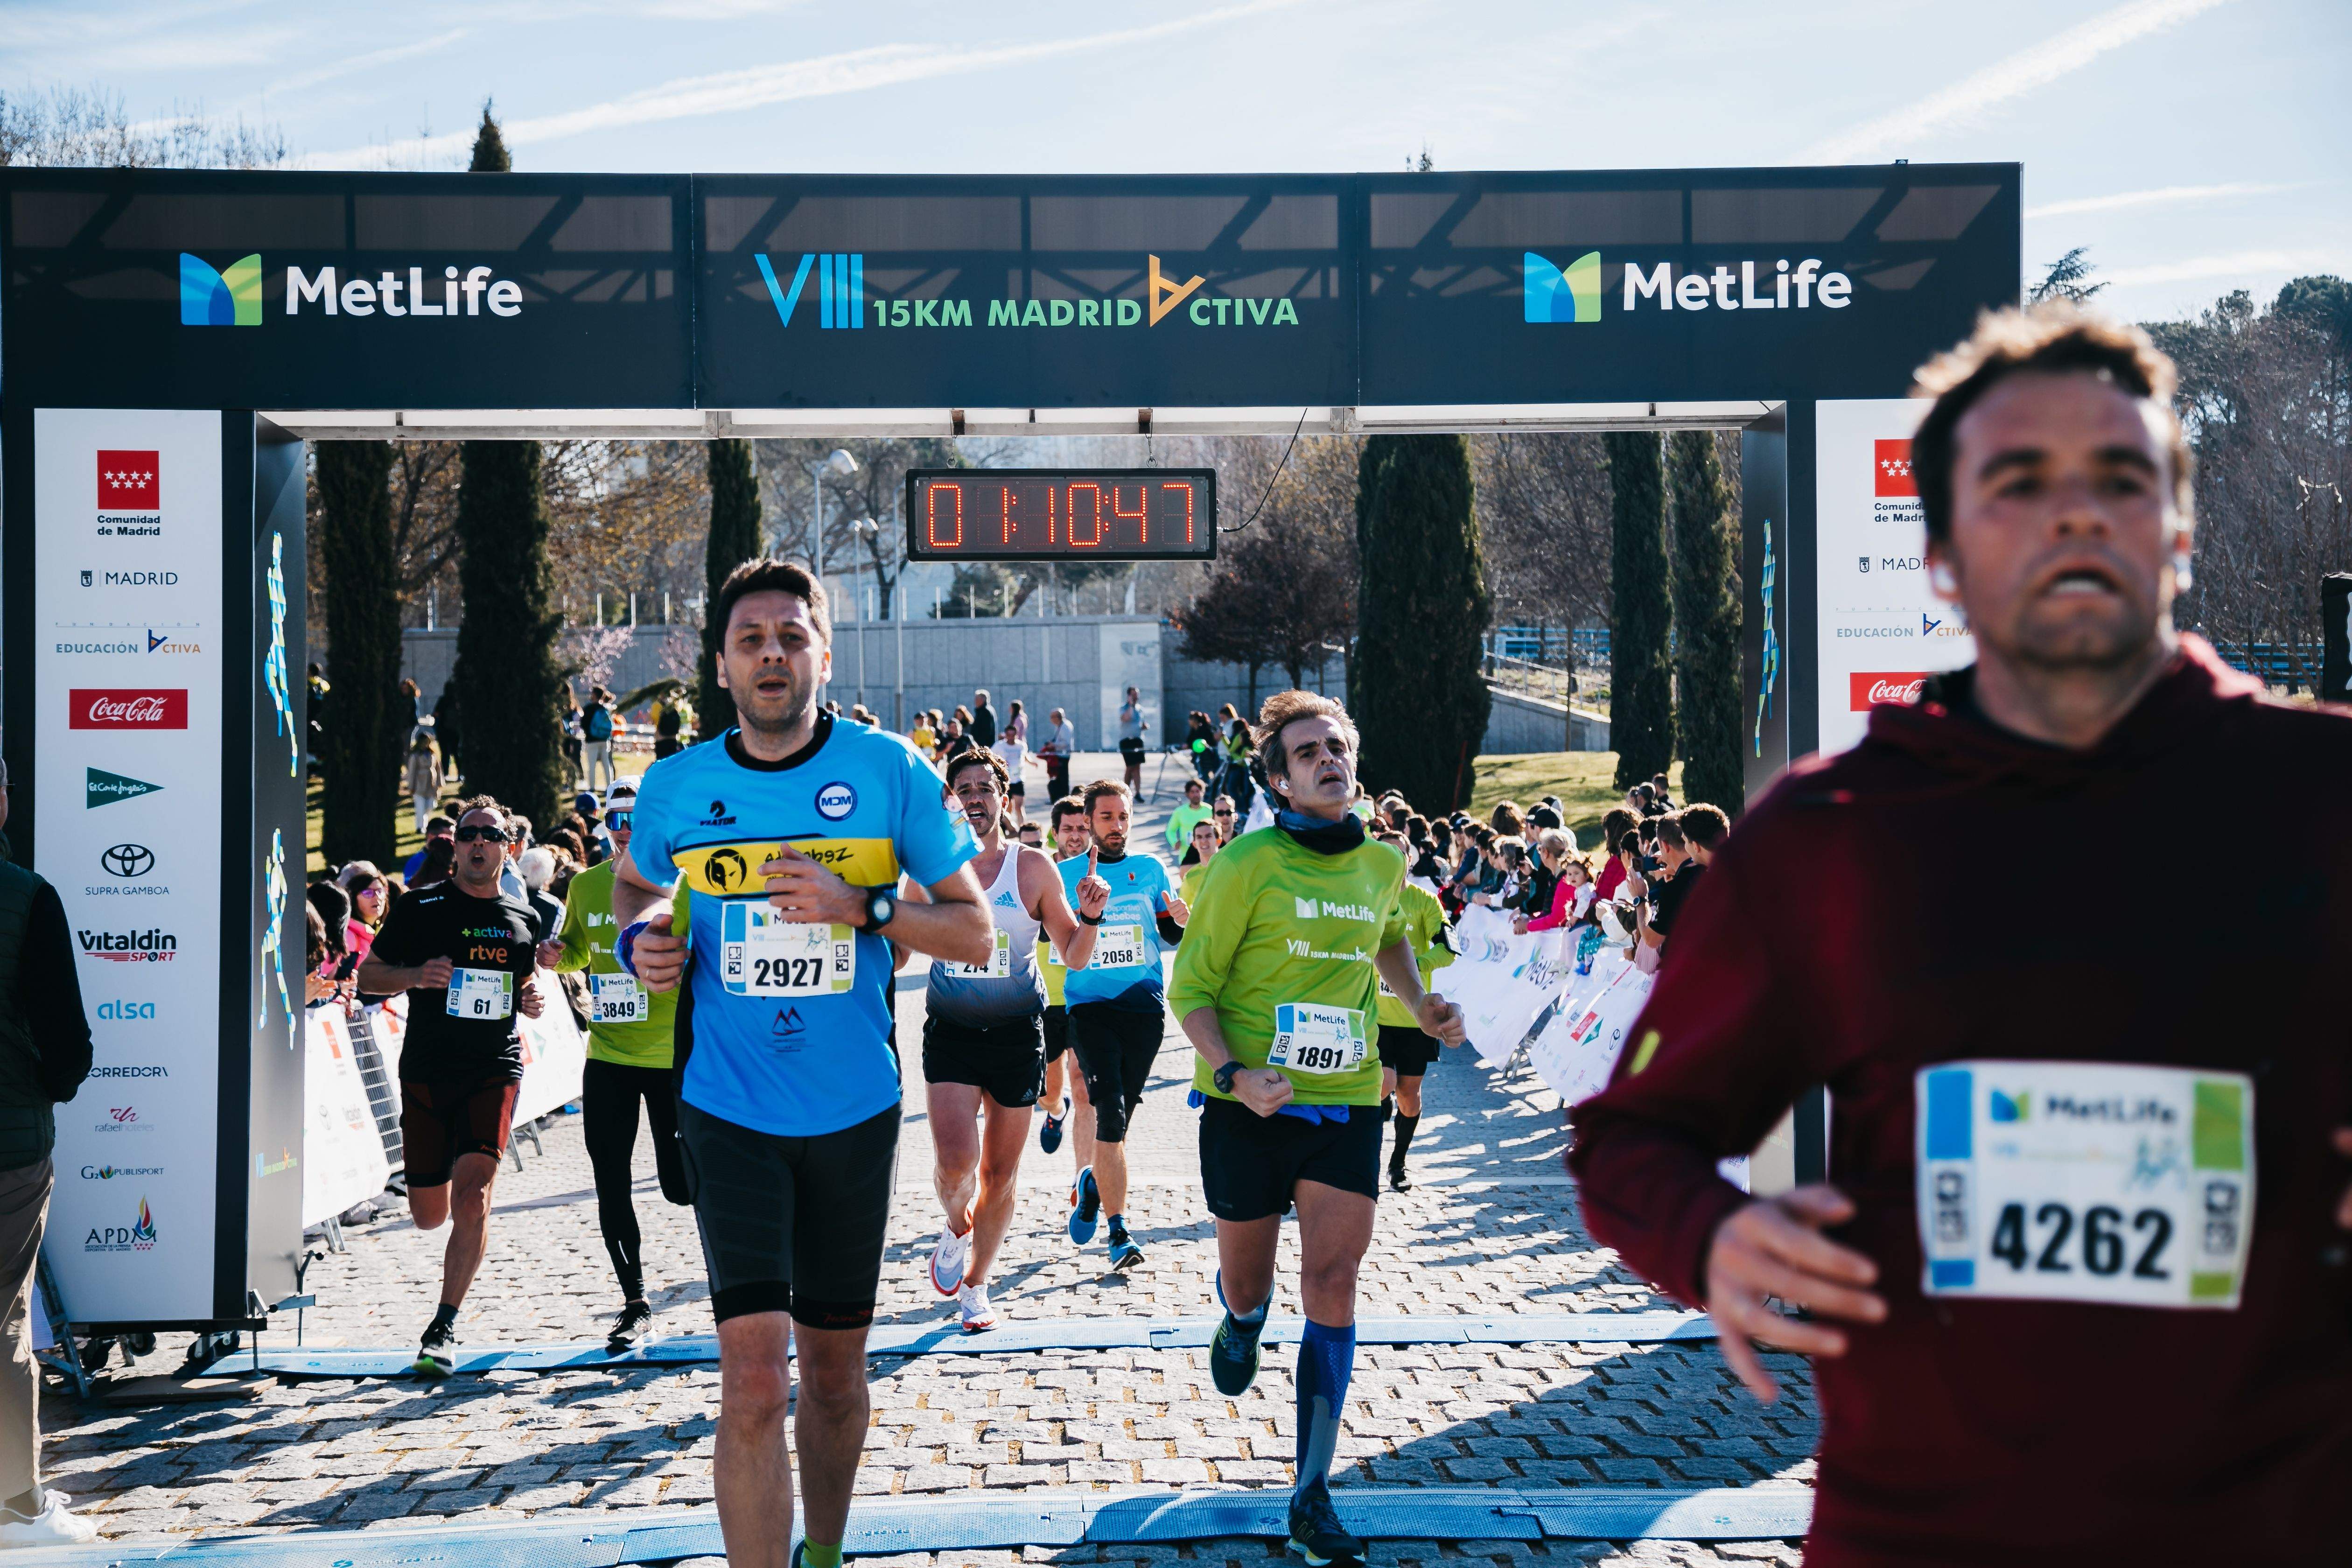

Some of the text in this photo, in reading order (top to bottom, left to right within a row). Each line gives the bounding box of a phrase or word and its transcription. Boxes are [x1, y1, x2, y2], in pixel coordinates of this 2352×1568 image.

[286, 266, 523, 316] MetLife
[755, 254, 864, 328] VIII
[874, 299, 972, 327] 15KM
[988, 299, 1141, 326] MADRID
[1624, 259, 1852, 310] MetLife
[97, 515, 160, 524] Comunidad
[1875, 514, 1889, 522] de
[97, 527, 160, 536] de Madrid
[105, 572, 178, 585] MADRID
[1837, 625, 1913, 637] EDUCACIÓN
[56, 641, 138, 653] EDUCACIÓN
[89, 697, 168, 721] Coca-Cola
[89, 781, 147, 794] El Corte Inglés
[85, 887, 169, 896] SUPRA GAMBOA
[994, 900, 1017, 908] adidas
[1323, 901, 1375, 923] MetLife
[77, 928, 176, 951] Vitaldin
[1287, 938, 1310, 957] VIII
[130, 952, 176, 962] SPORT
[470, 945, 507, 963] rtve
[1102, 950, 1133, 964] 2058
[754, 959, 823, 987] 2927
[98, 1000, 154, 1020] alsa
[474, 998, 491, 1015] 61
[602, 1001, 635, 1017] 3849
[1314, 1013, 1346, 1025] MetLife
[1297, 1046, 1344, 1069] 1891
[2046, 1090, 2177, 1125] MetLife
[1990, 1203, 2173, 1281] 4262
